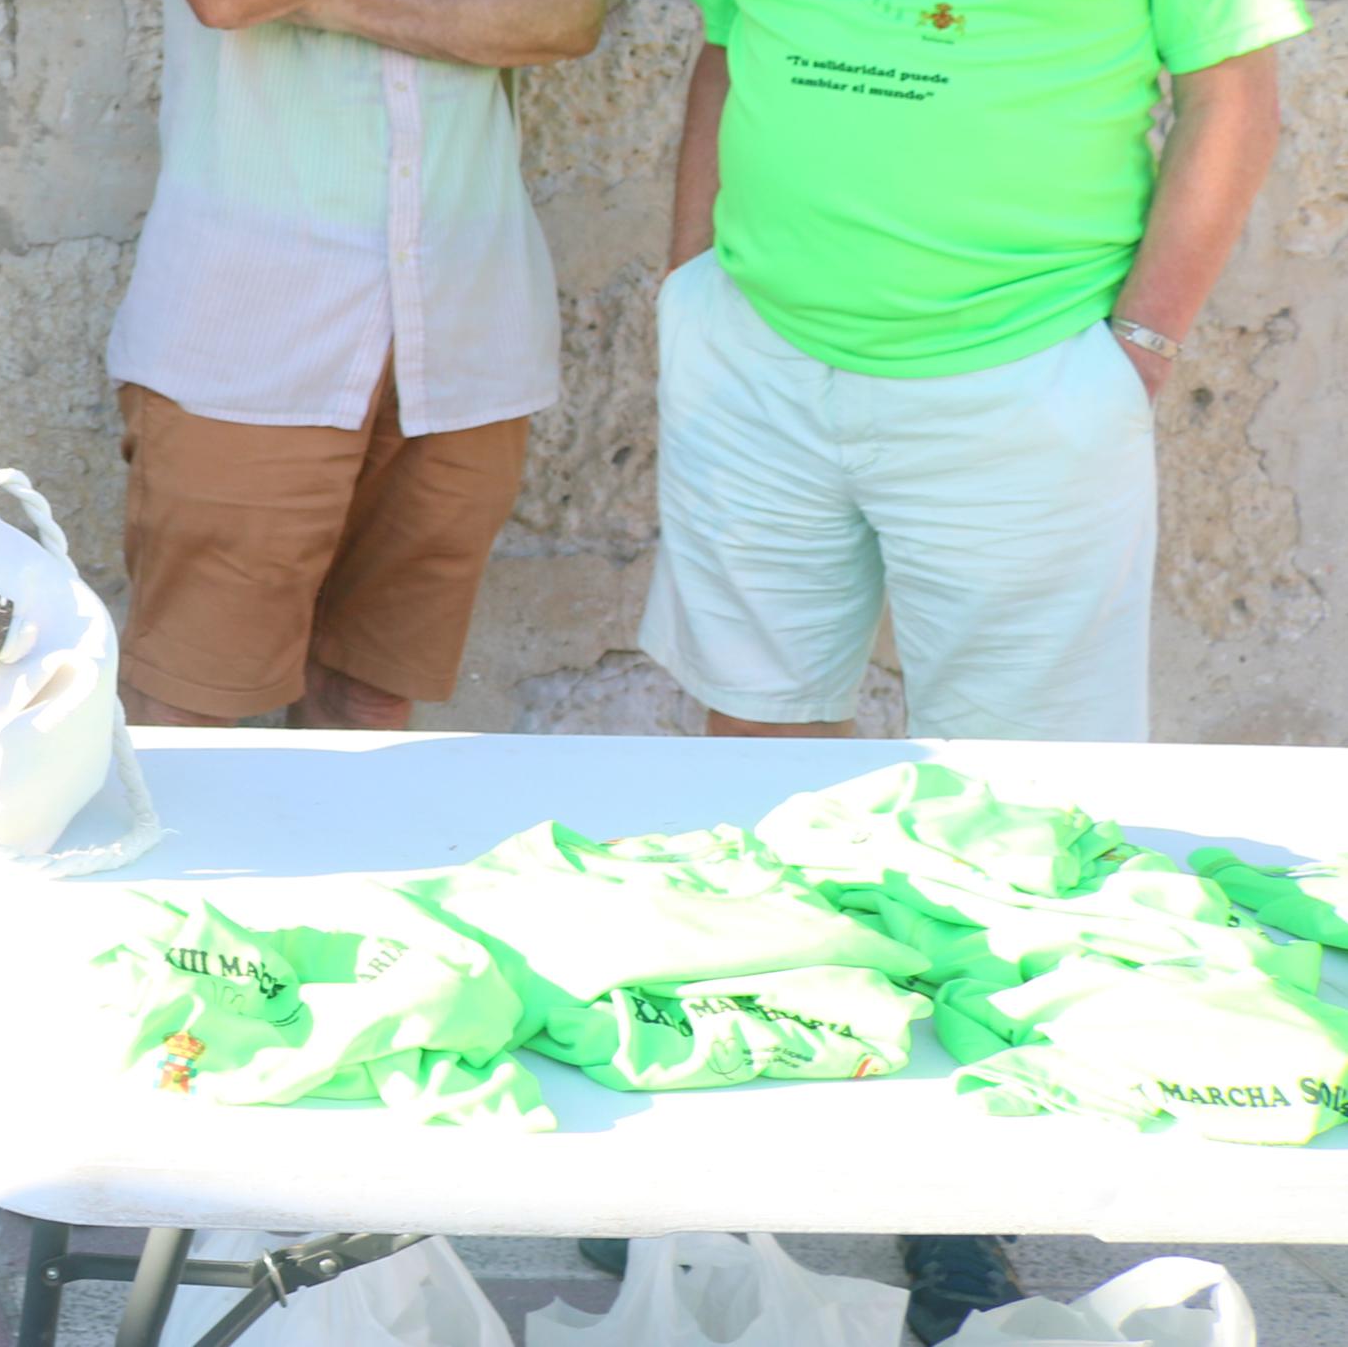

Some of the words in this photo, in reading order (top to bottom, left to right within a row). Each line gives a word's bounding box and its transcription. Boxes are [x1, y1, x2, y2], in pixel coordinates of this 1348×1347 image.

[813, 59, 895, 78] solidaridad
[900, 70, 950, 84] puede
[791, 76, 848, 92] cambiar
[852, 84, 865, 94] el
[1156, 1080, 1292, 1108] MARCHA
